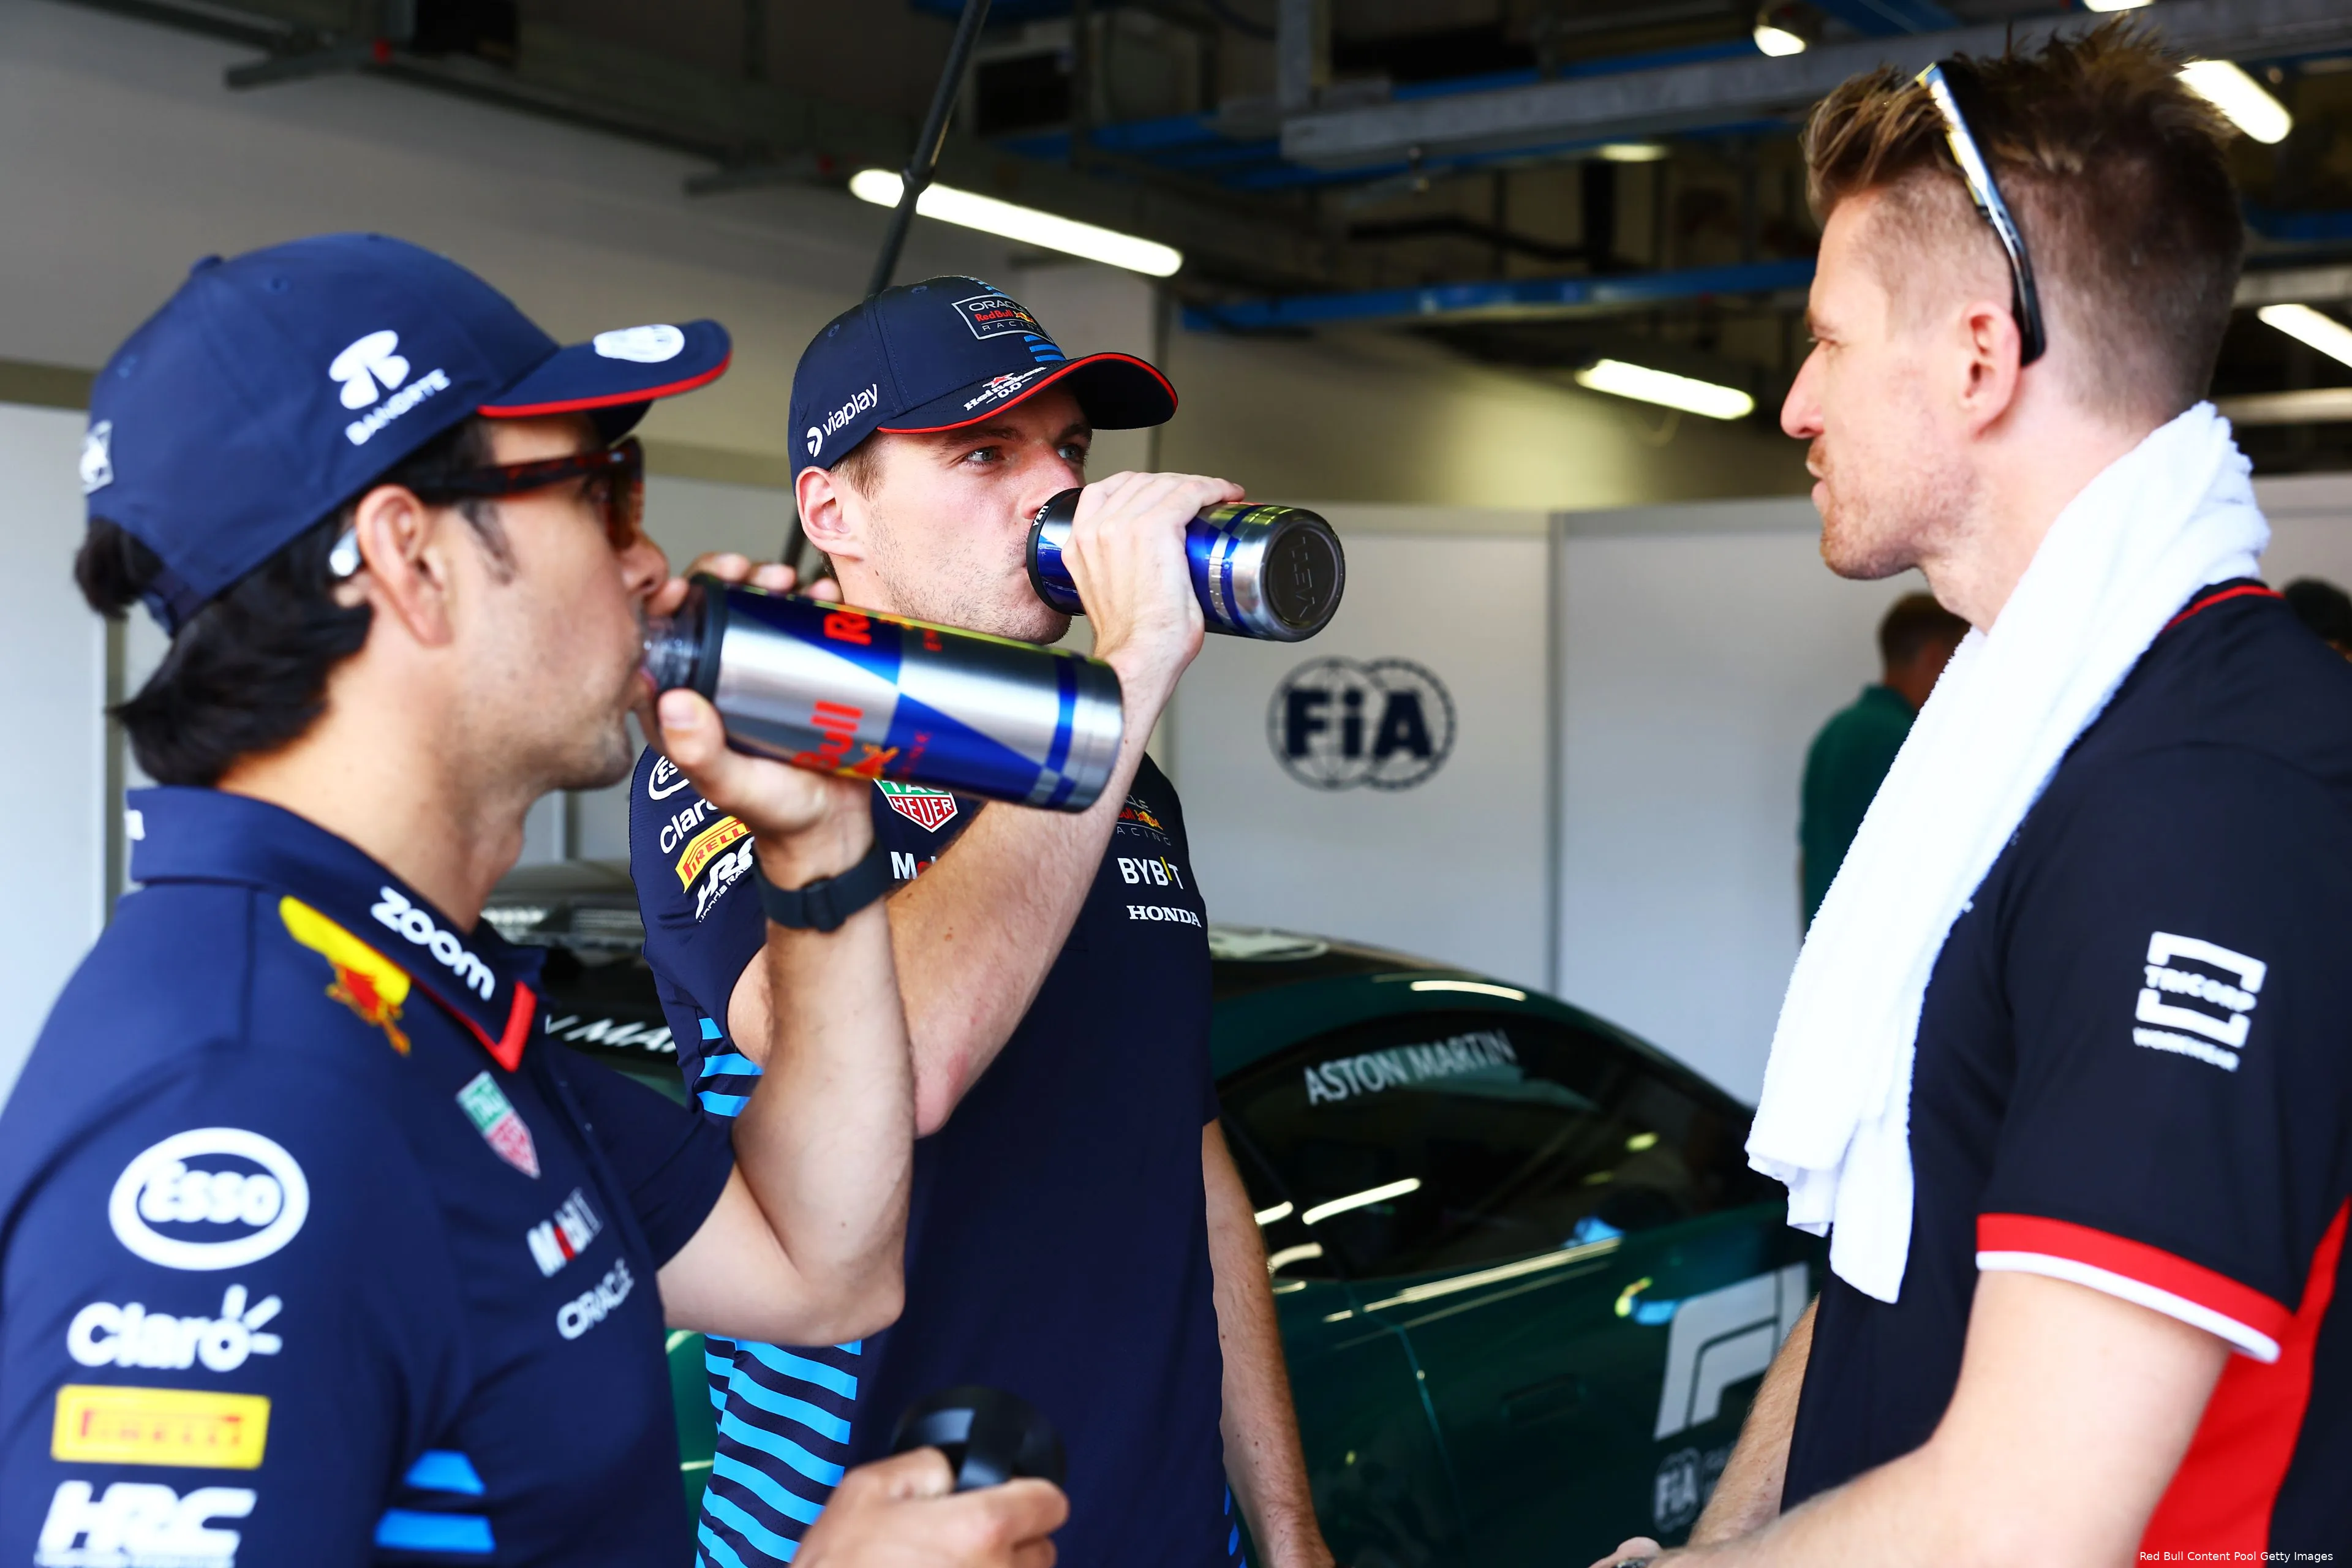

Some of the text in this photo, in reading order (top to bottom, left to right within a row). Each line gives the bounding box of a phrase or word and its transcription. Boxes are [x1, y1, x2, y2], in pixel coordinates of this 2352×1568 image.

[968, 300, 1030, 316] ORACLE
[822, 383, 878, 437] viaplay
[963, 367, 1047, 411] Heineken
[891, 797, 952, 826] HEUER
[1117, 826, 1172, 846] ACING
[1117, 856, 1184, 890] BYBIT
[1126, 905, 1202, 928] HONDA
[371, 885, 496, 1002] zoom
[1303, 1028, 1517, 1107] ASTON MARTIN
[139, 1159, 284, 1227] Esso
[66, 1300, 254, 1373] Claro
[37, 1479, 258, 1555] HRC
